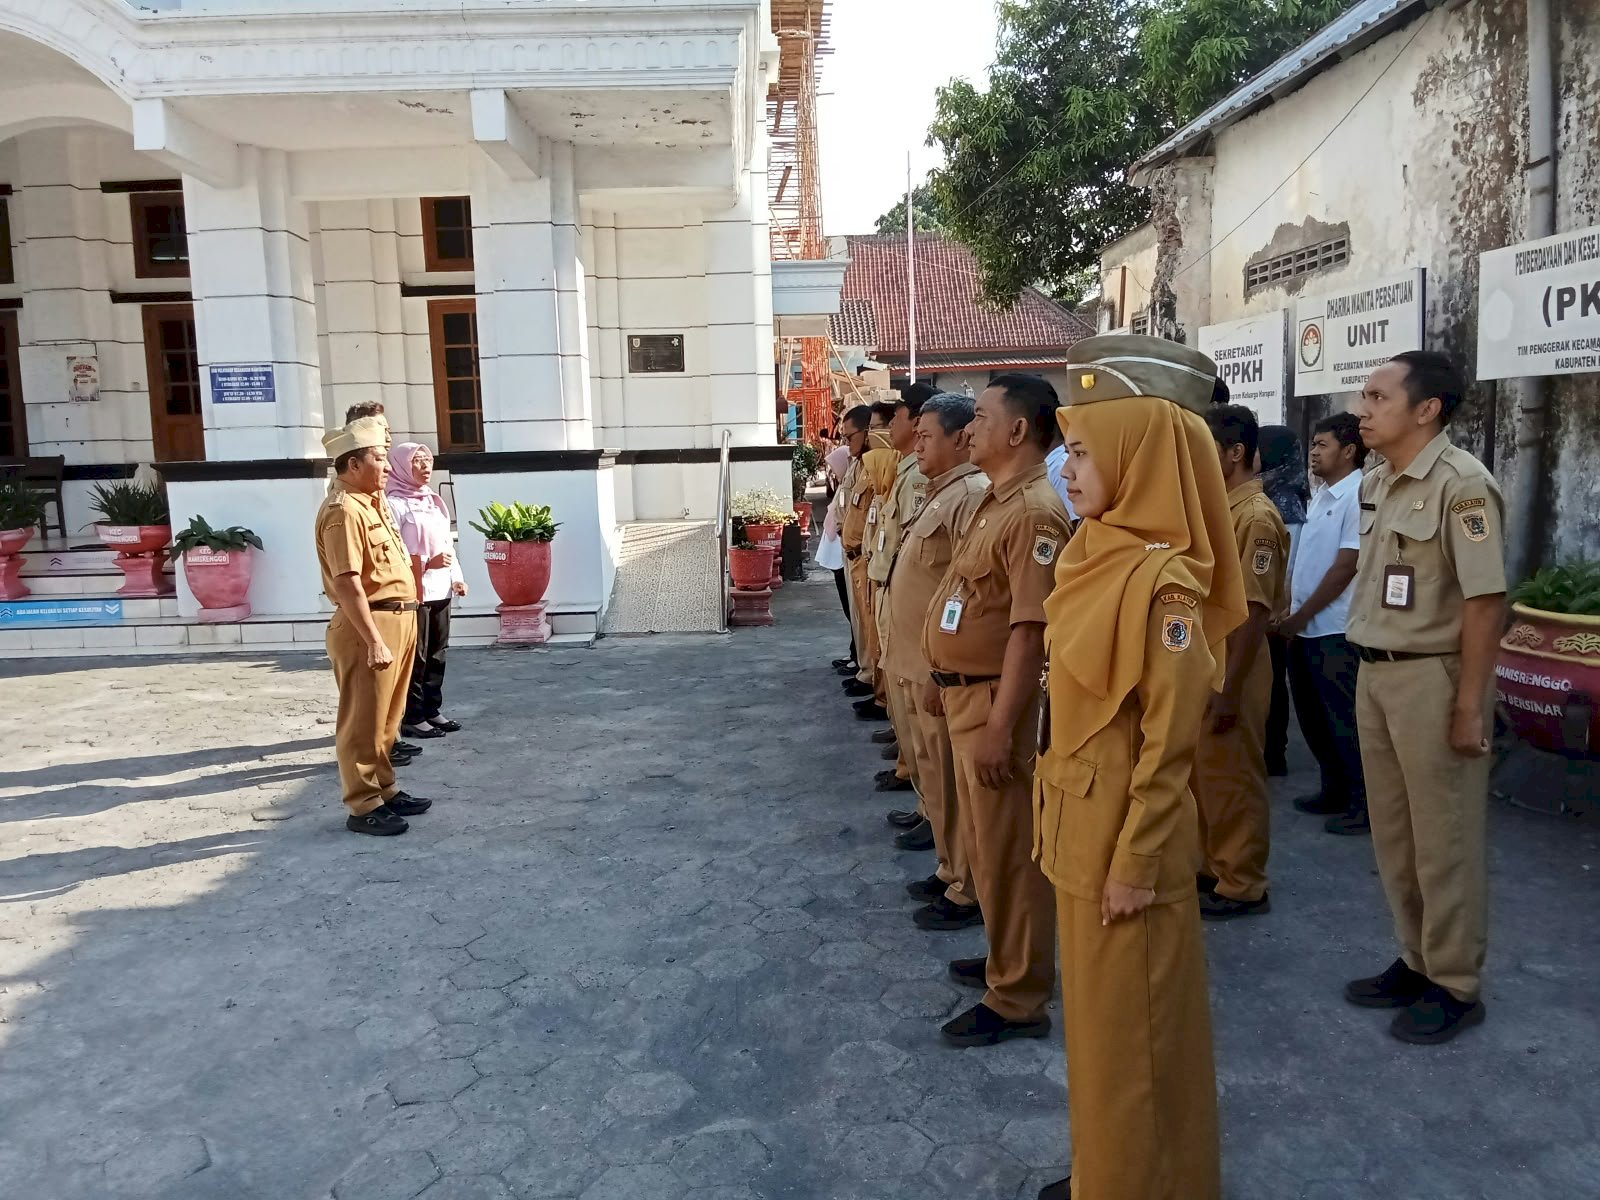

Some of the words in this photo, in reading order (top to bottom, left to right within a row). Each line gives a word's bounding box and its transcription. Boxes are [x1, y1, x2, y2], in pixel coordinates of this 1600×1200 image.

[1516, 242, 1562, 276] PEMBERDAYAAN
[1564, 240, 1576, 266] DAN
[1326, 296, 1350, 320] DHARMA
[1351, 289, 1374, 315] WANITA
[1376, 280, 1413, 310] PERSATUAN
[1348, 320, 1389, 348] UNIT
[1214, 343, 1263, 361] SEKRETARIAT
[1518, 346, 1528, 356] TIM
[1530, 340, 1570, 355] PENGGERAK
[1334, 360, 1364, 372] KECAMATAN
[1555, 356, 1596, 370] KABUPATEN
[1494, 664, 1572, 692] MANISRENGGO
[1508, 694, 1564, 716] BERSINAR
